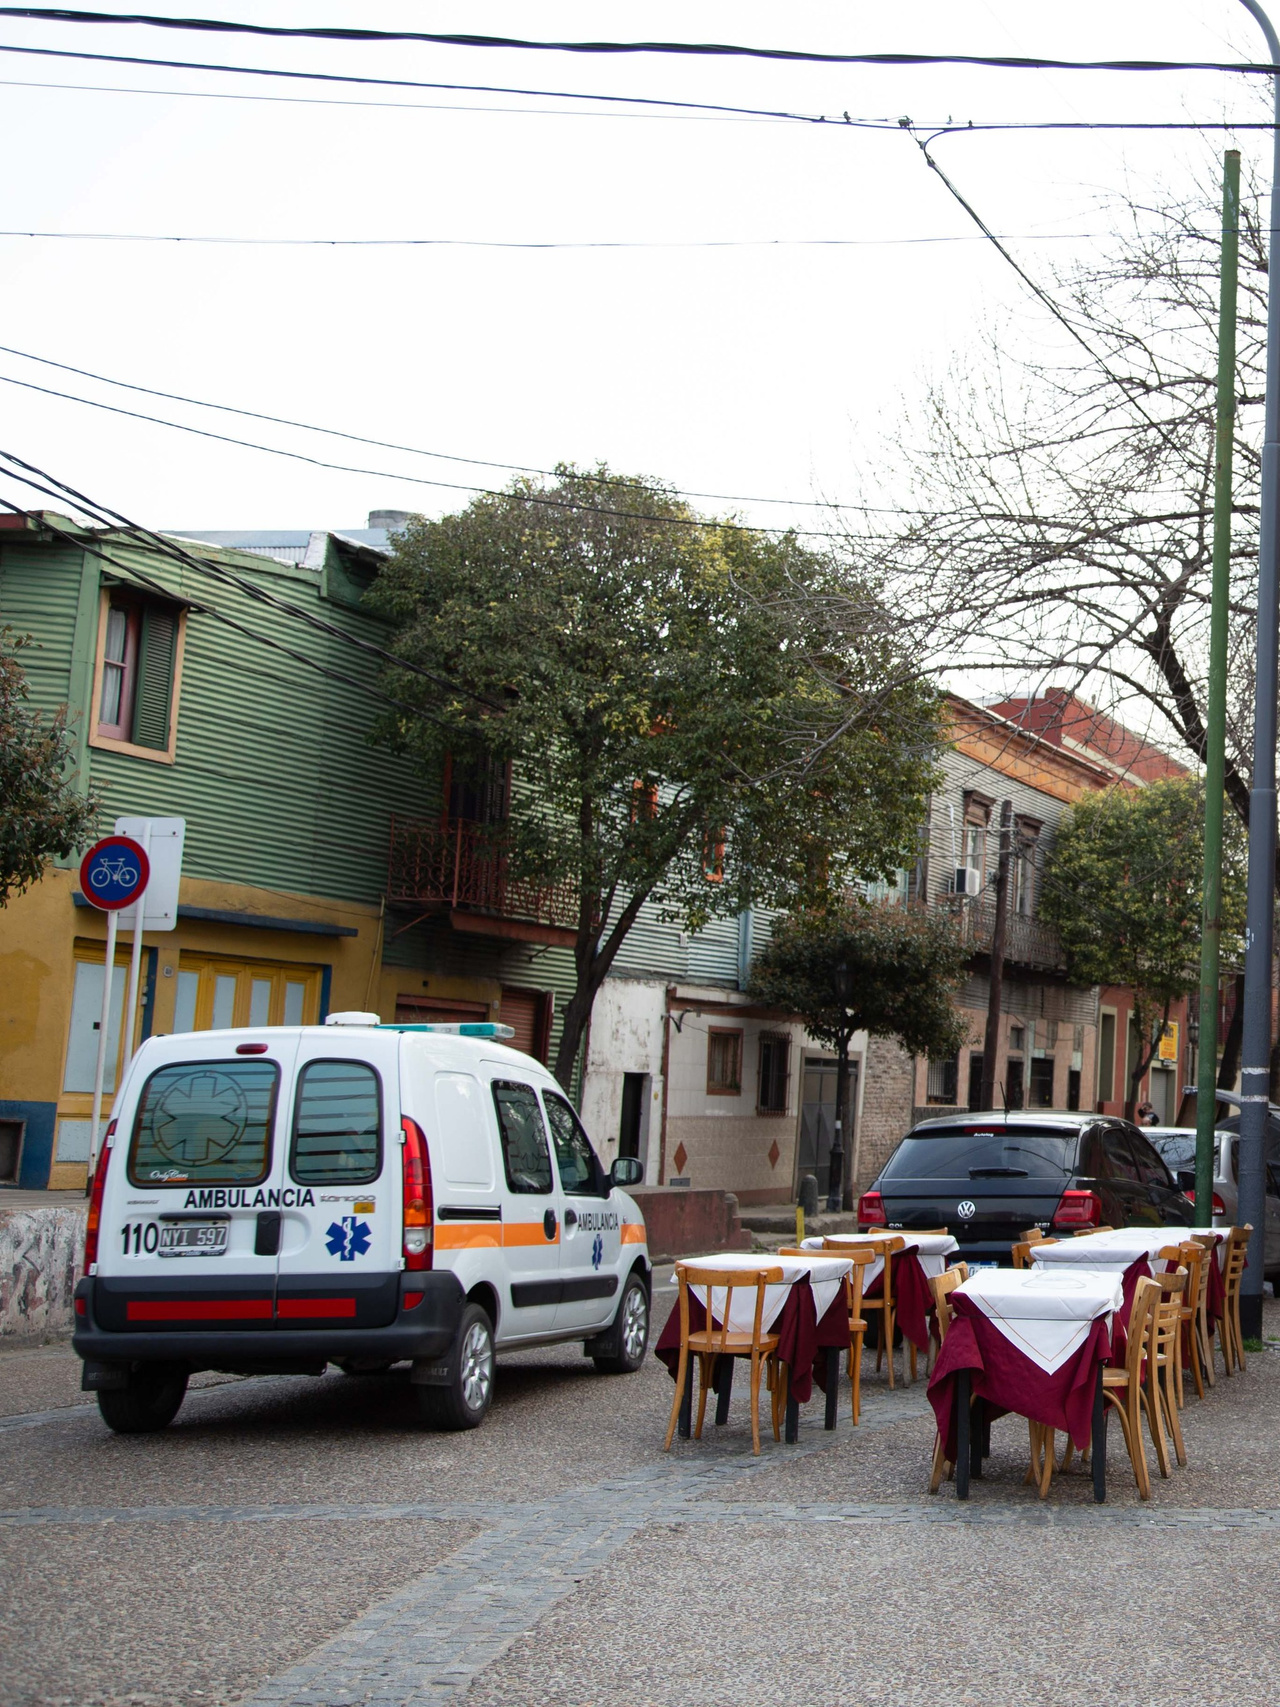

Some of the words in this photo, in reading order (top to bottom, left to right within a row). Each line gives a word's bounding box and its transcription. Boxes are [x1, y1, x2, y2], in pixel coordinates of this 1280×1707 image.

[184, 1189, 315, 1209] AMBULANCIA
[577, 1212, 619, 1231] AMBULANCIA
[121, 1222, 160, 1255] 110
[198, 1228, 226, 1246] 597
